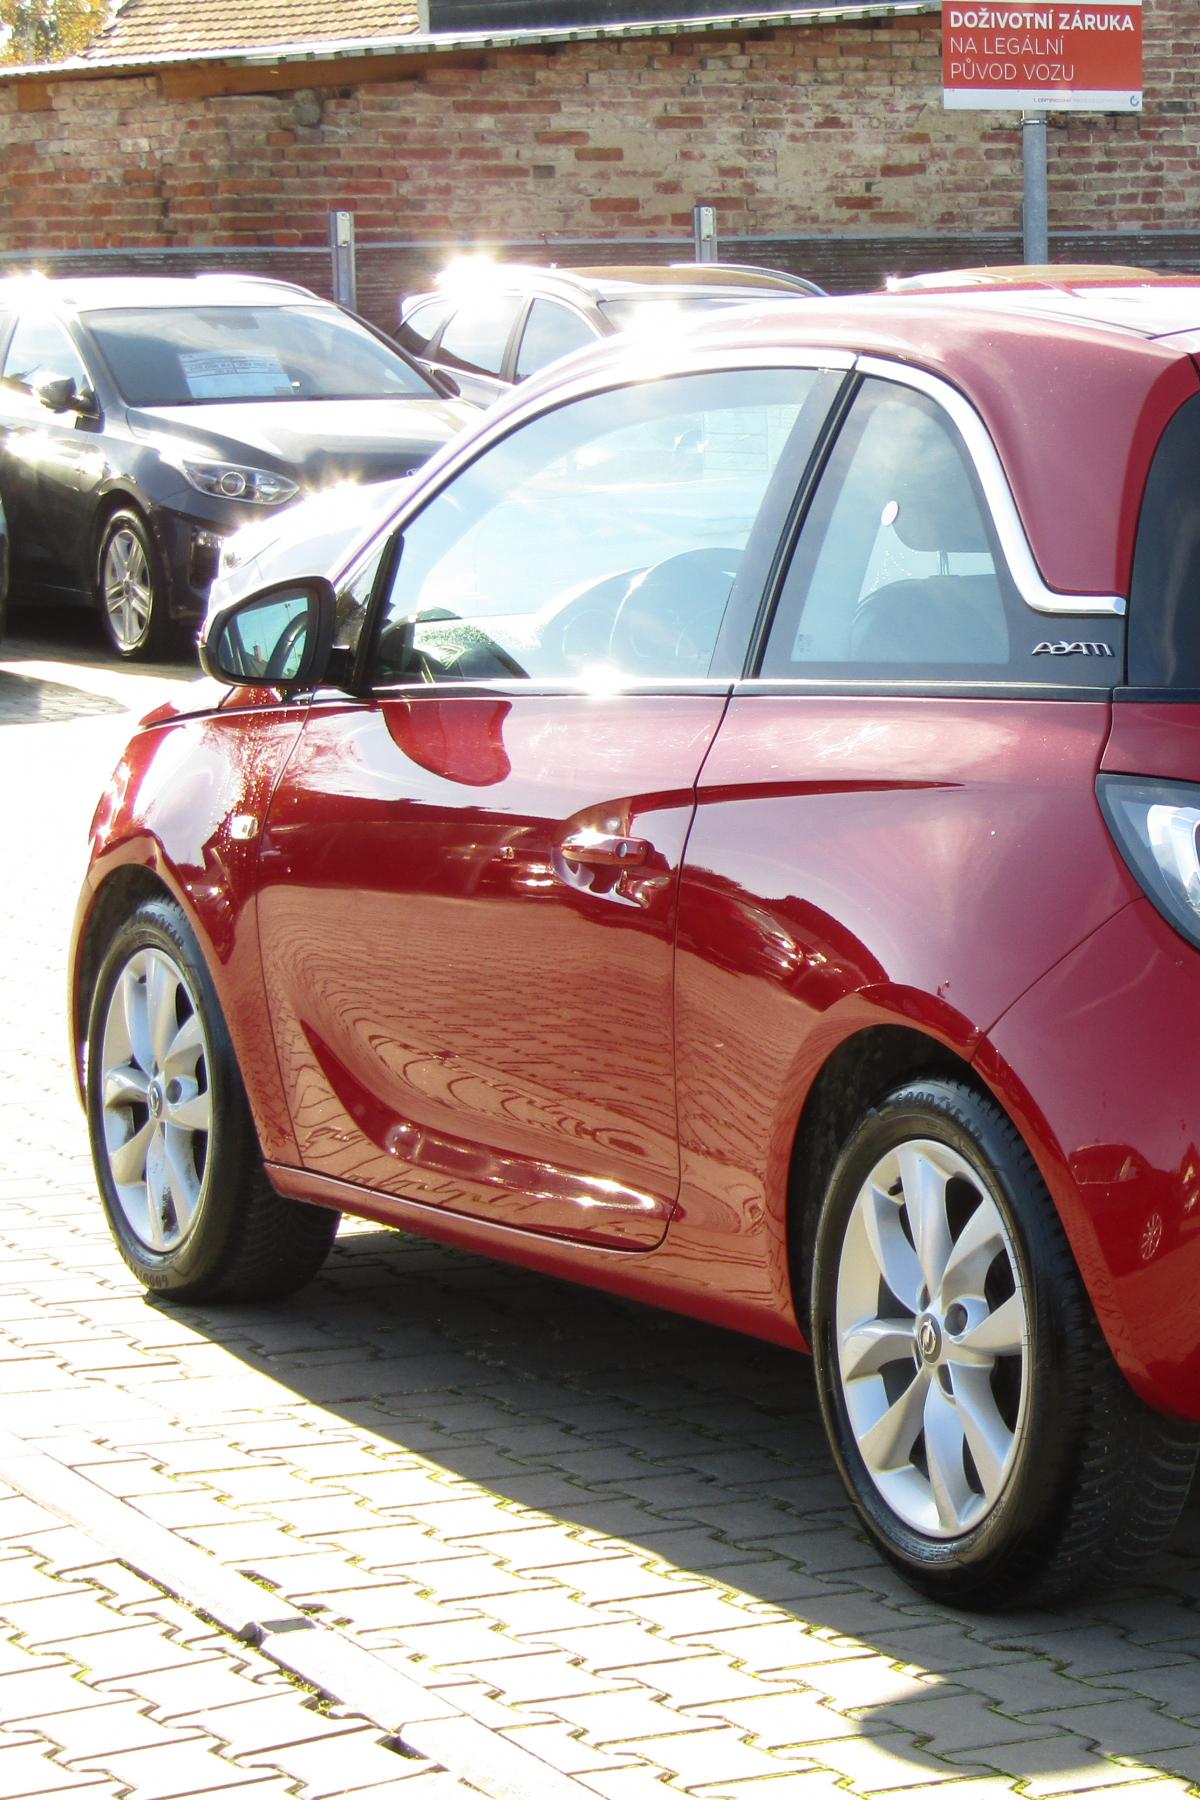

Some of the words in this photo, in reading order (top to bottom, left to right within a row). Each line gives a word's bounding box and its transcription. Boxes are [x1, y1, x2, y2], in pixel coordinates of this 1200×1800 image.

[950, 8, 1054, 30] DOŽIVOTNÍ
[1058, 10, 1135, 31] ZÁRUKA
[950, 37, 978, 54] NA
[984, 35, 1064, 55] LEGÁLNÍ
[951, 57, 1017, 80] PŮVOD
[1023, 63, 1075, 81] VOZU
